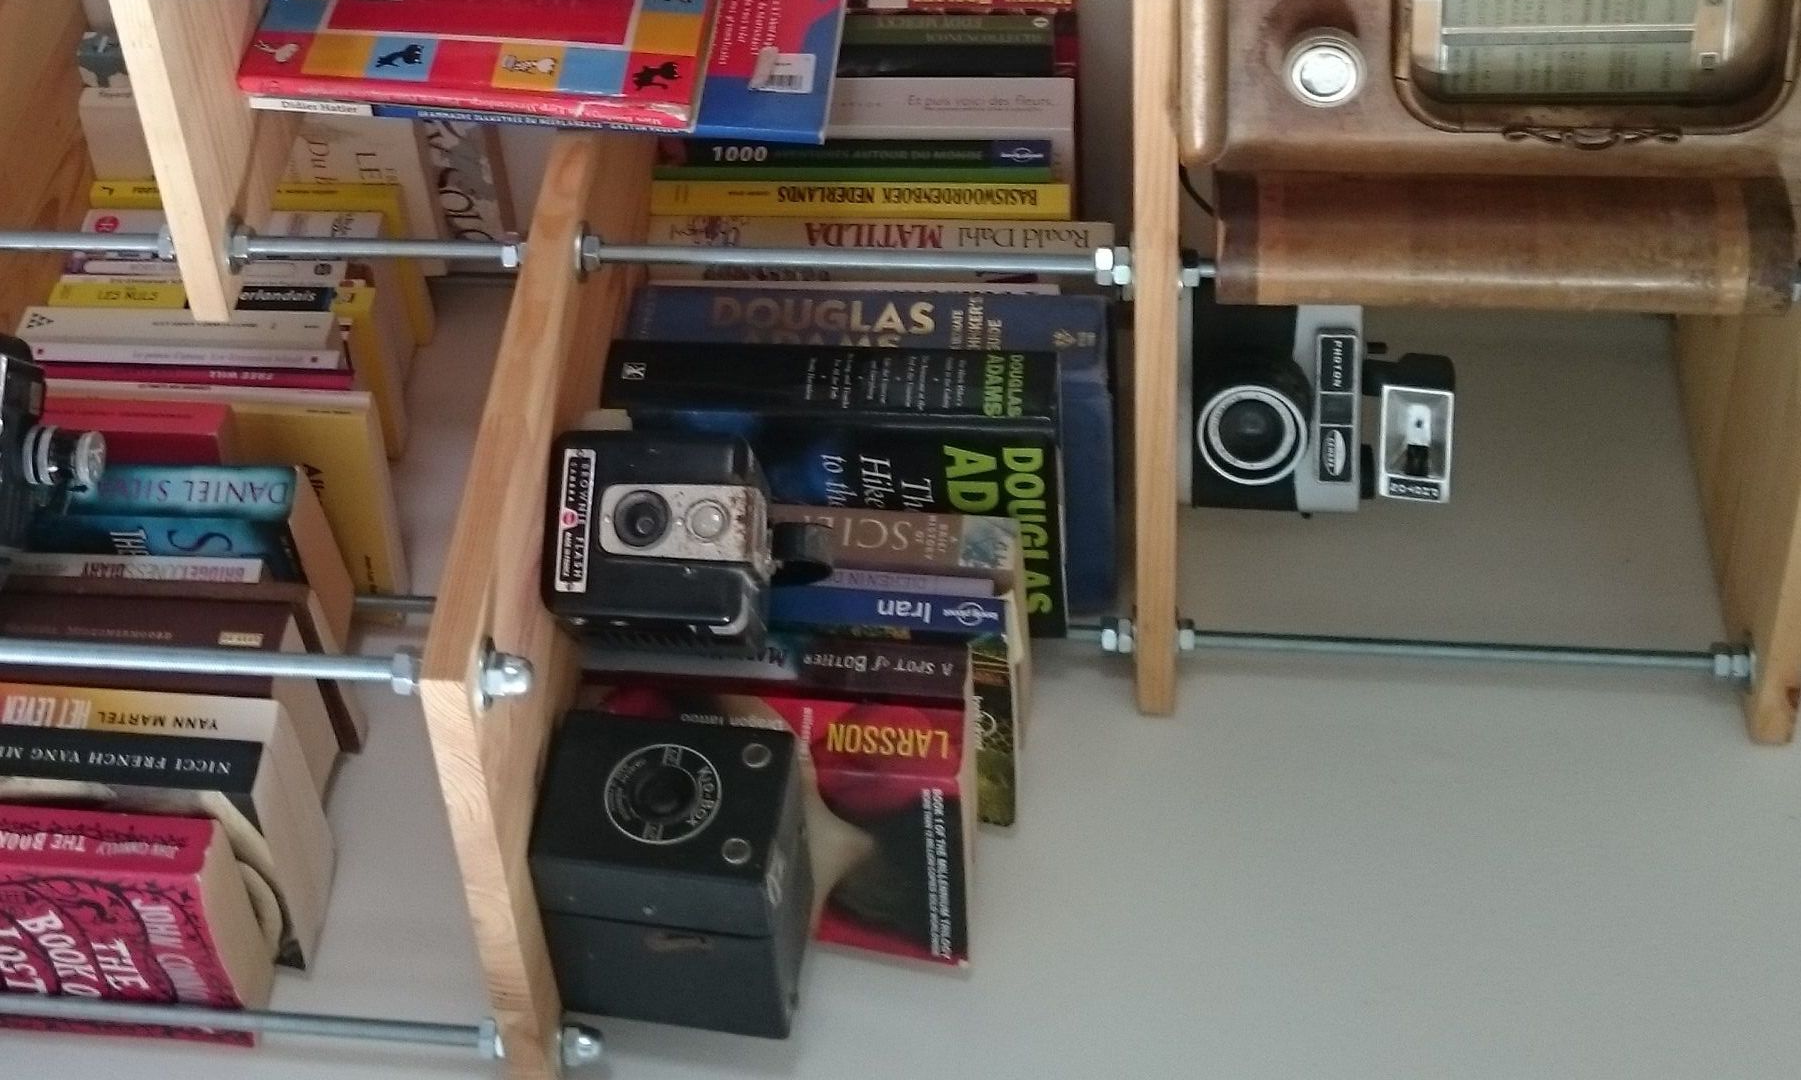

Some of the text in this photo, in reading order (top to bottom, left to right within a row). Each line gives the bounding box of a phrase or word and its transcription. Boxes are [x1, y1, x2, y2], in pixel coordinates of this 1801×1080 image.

[712, 146, 768, 162] 1000
[777, 185, 875, 204] NEDERLANDS
[881, 188, 1038, 207] BASISWOORDENBOEK
[804, 221, 1090, 250] Roald Dahl MATILDA
[237, 289, 317, 304] erlandais
[713, 295, 936, 335] DOUGLAS
[1332, 339, 1344, 389] PHOTON
[983, 354, 1004, 417] ADAMS
[1007, 353, 1024, 418] DOUGLAS
[819, 453, 848, 474] to
[183, 479, 288, 506] DANIEL
[943, 445, 998, 512] AD
[577, 462, 590, 525] BROWNIE
[902, 476, 936, 514] Th
[1001, 446, 1052, 616] DOUGLAS
[573, 536, 585, 579] FLASH
[876, 599, 932, 624] Iran
[894, 656, 938, 674] SPOT
[942, 661, 954, 675] A
[97, 710, 166, 727] MARTEL
[172, 715, 219, 731] YANN
[826, 721, 951, 758] LARSSON
[30, 746, 232, 775] NICCI FRENCH VANG
[49, 832, 87, 853] THE
[130, 897, 184, 950] JOHN
[17, 908, 103, 998] BOOK O
[90, 936, 149, 991] THE
